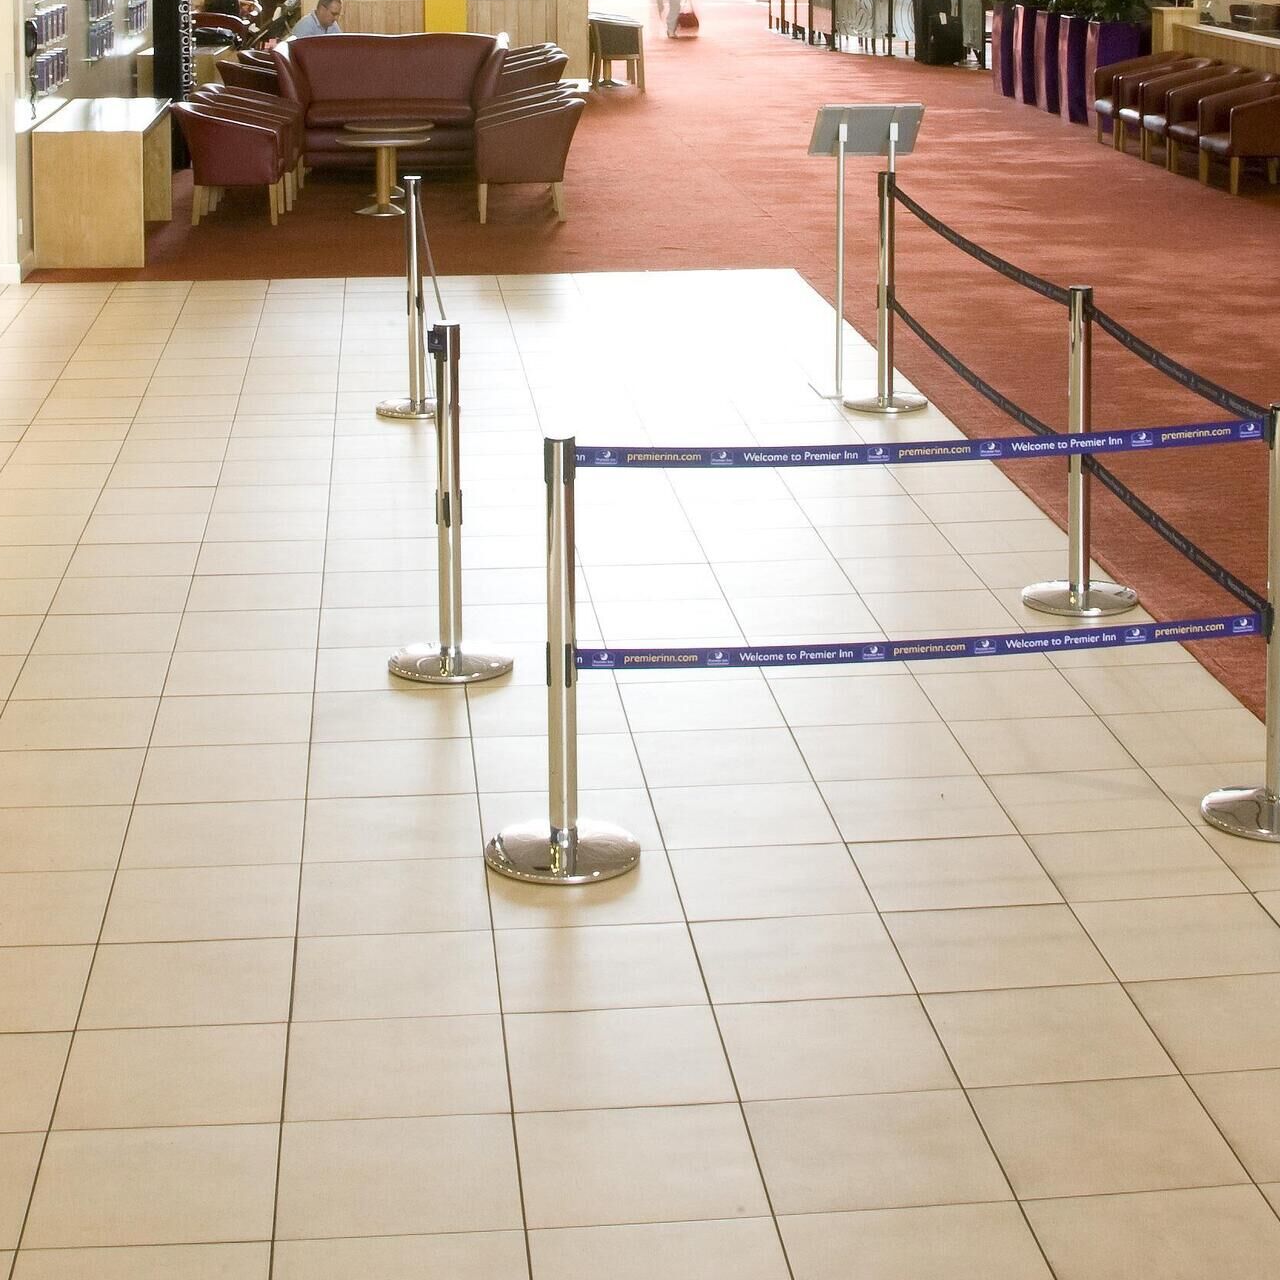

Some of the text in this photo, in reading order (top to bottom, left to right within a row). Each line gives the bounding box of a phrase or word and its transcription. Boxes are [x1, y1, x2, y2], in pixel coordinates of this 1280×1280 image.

[627, 452, 702, 462] premierinn.com
[744, 452, 788, 462] Welcome
[791, 453, 801, 461] to
[804, 451, 841, 460] Premier
[844, 450, 858, 459] Inn
[898, 445, 971, 458] premierinn.com
[1012, 441, 1055, 452] Welcome
[1058, 441, 1067, 449] to
[1070, 438, 1106, 448] Premier
[1109, 436, 1123, 445] Inn
[1161, 427, 1231, 442] premierinn.com
[624, 653, 698, 664] premierinn.com
[740, 652, 784, 661] Welcome
[800, 650, 836, 659] Premier
[839, 649, 853, 658] Inn
[893, 643, 965, 656] premierinn.com
[1005, 639, 1049, 649] Welcome
[1051, 638, 1062, 646] to
[1064, 635, 1100, 644] Premier
[1102, 633, 1117, 642] Inn
[1154, 622, 1225, 638] premierinn.com
